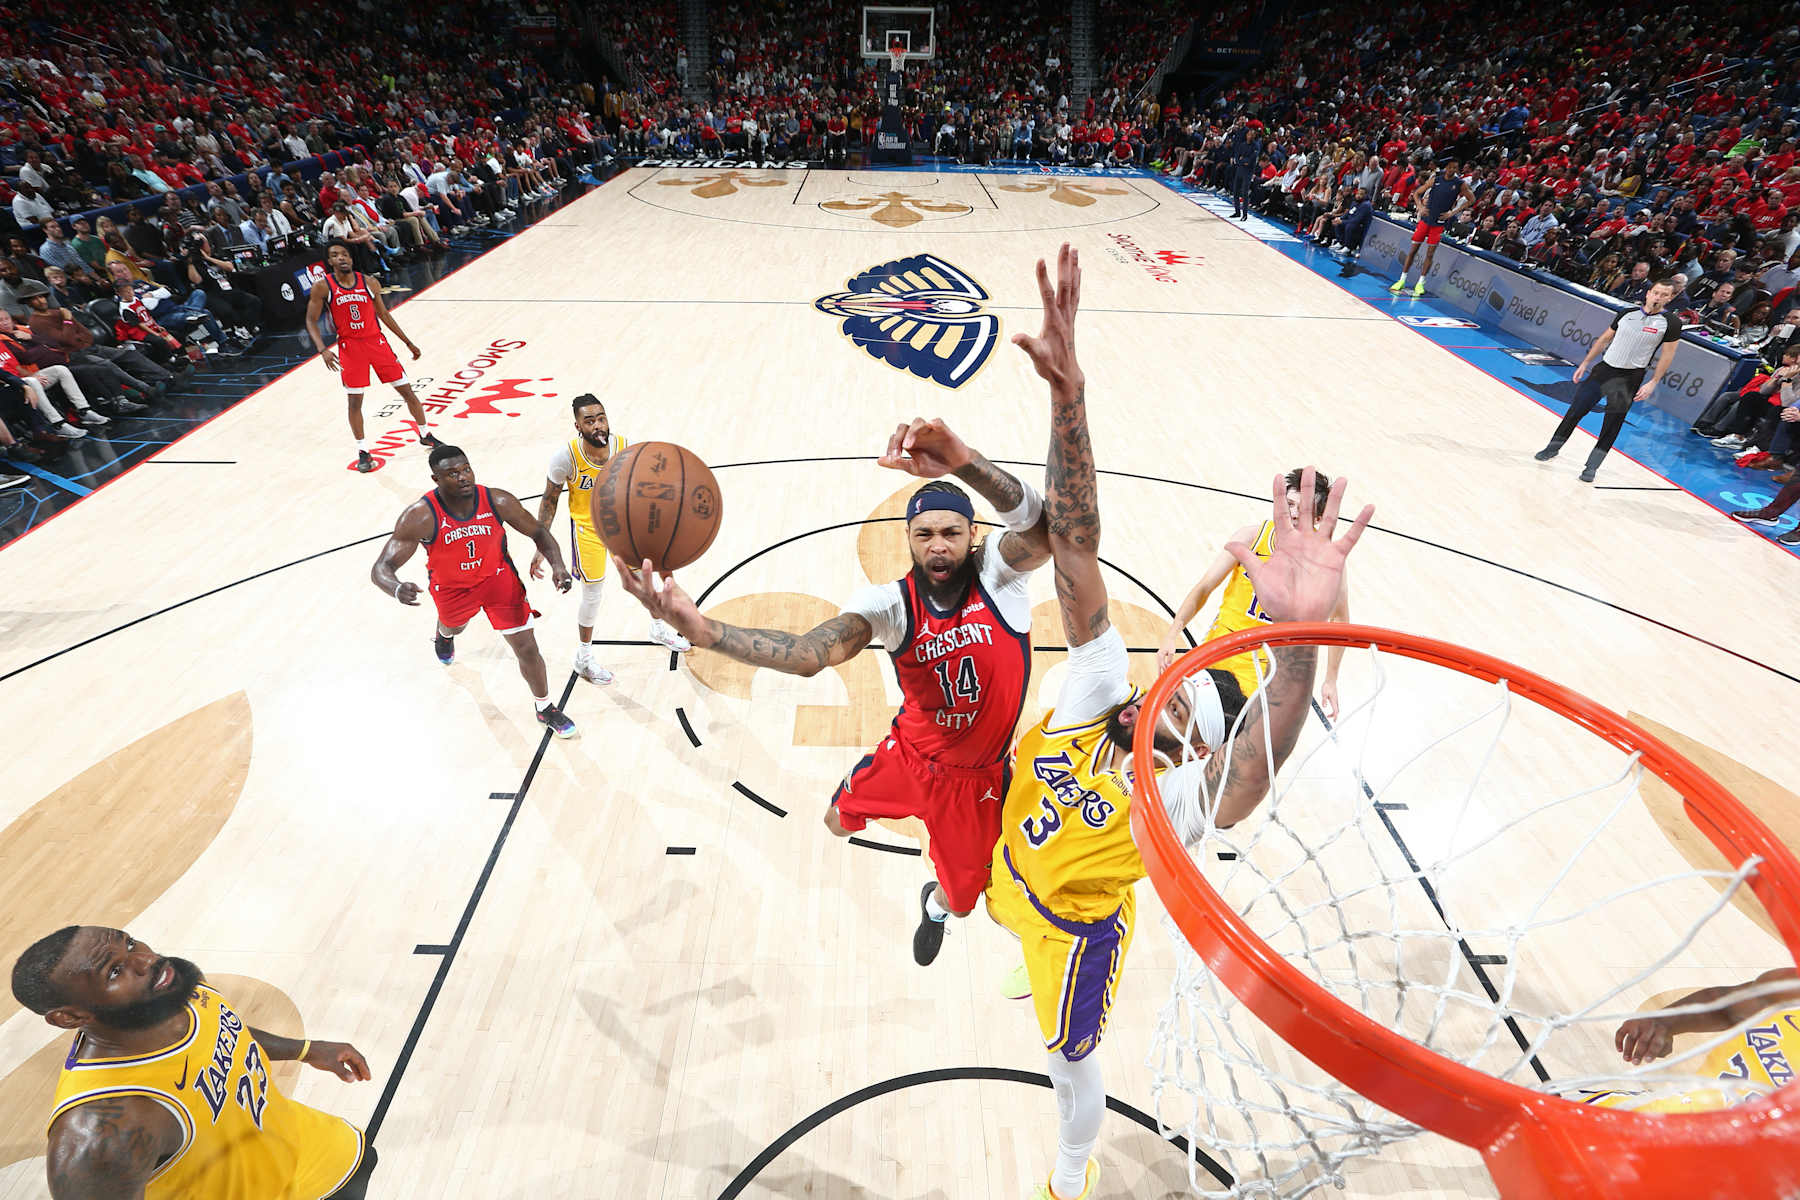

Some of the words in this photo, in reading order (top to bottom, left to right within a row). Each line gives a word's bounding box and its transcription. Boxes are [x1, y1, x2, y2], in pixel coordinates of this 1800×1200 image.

[636, 159, 809, 169] PELICANS
[349, 304, 361, 321] 5
[1449, 270, 1487, 299] Google
[1507, 296, 1537, 322] Pixel
[1536, 309, 1549, 326] 8
[350, 321, 365, 330] CITY
[421, 338, 527, 415] SMOOTHIE
[1561, 320, 1599, 349] Goo
[1686, 377, 1704, 397] 8
[444, 524, 492, 545] CRESCENT
[465, 540, 476, 559] 1
[460, 558, 483, 571] CITY
[915, 623, 993, 663] CRESCENT
[934, 655, 982, 708] 14
[935, 709, 978, 730] CITY
[1033, 751, 1115, 828] LAKERS
[1111, 775, 1132, 797] bibig
[1019, 796, 1062, 850] 3
[193, 1003, 243, 1126] LAKERS
[236, 1040, 269, 1132] 23
